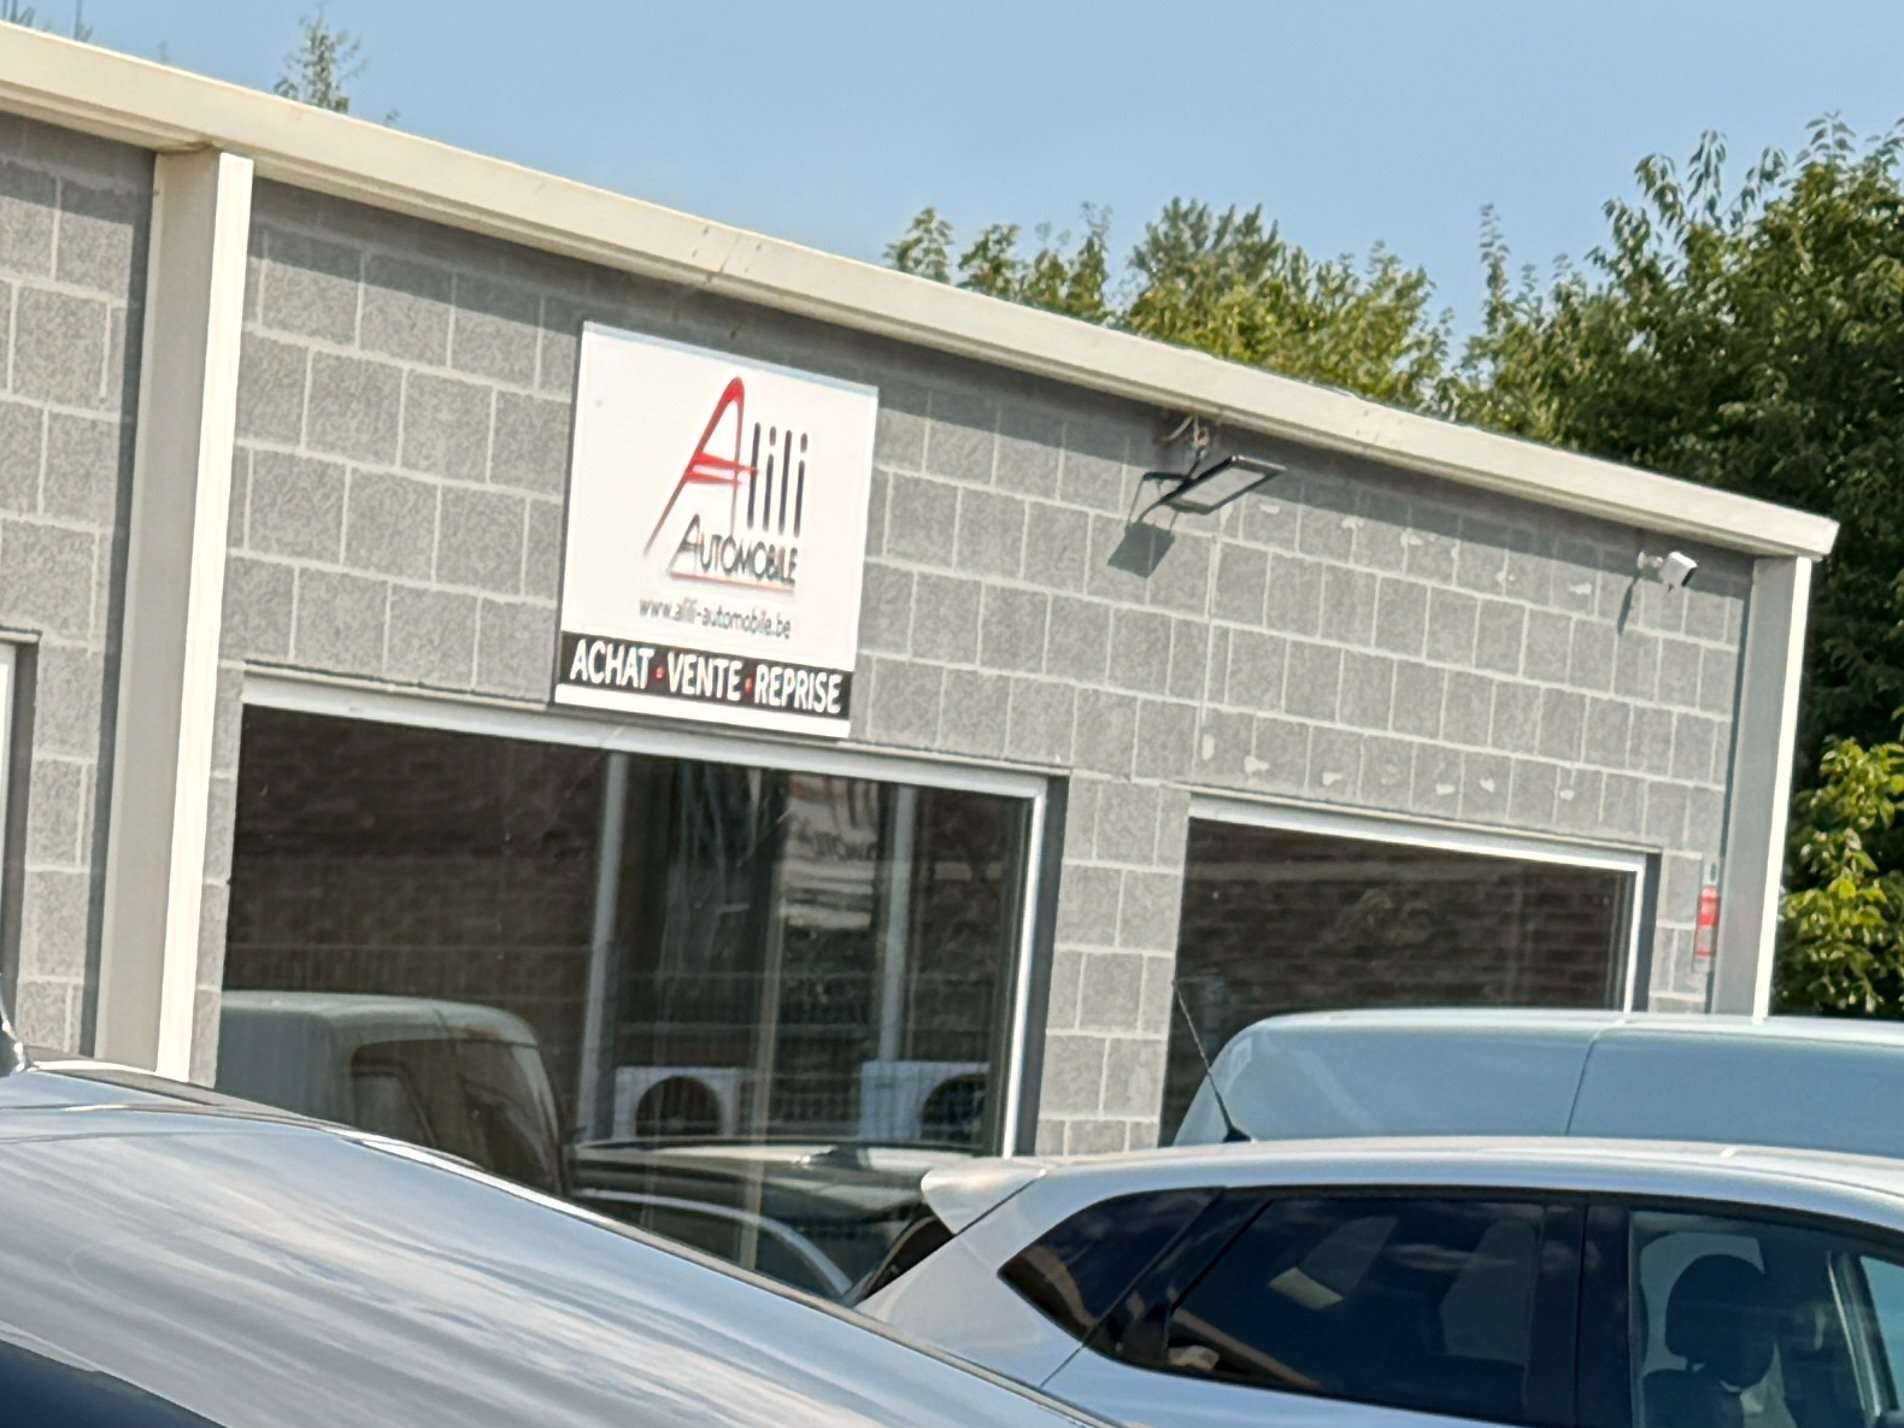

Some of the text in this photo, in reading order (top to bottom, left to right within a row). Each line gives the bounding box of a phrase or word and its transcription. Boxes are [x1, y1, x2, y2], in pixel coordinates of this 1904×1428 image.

[644, 377, 809, 557] Alili
[569, 638, 843, 714] ACHAT VENTE REPRISE
